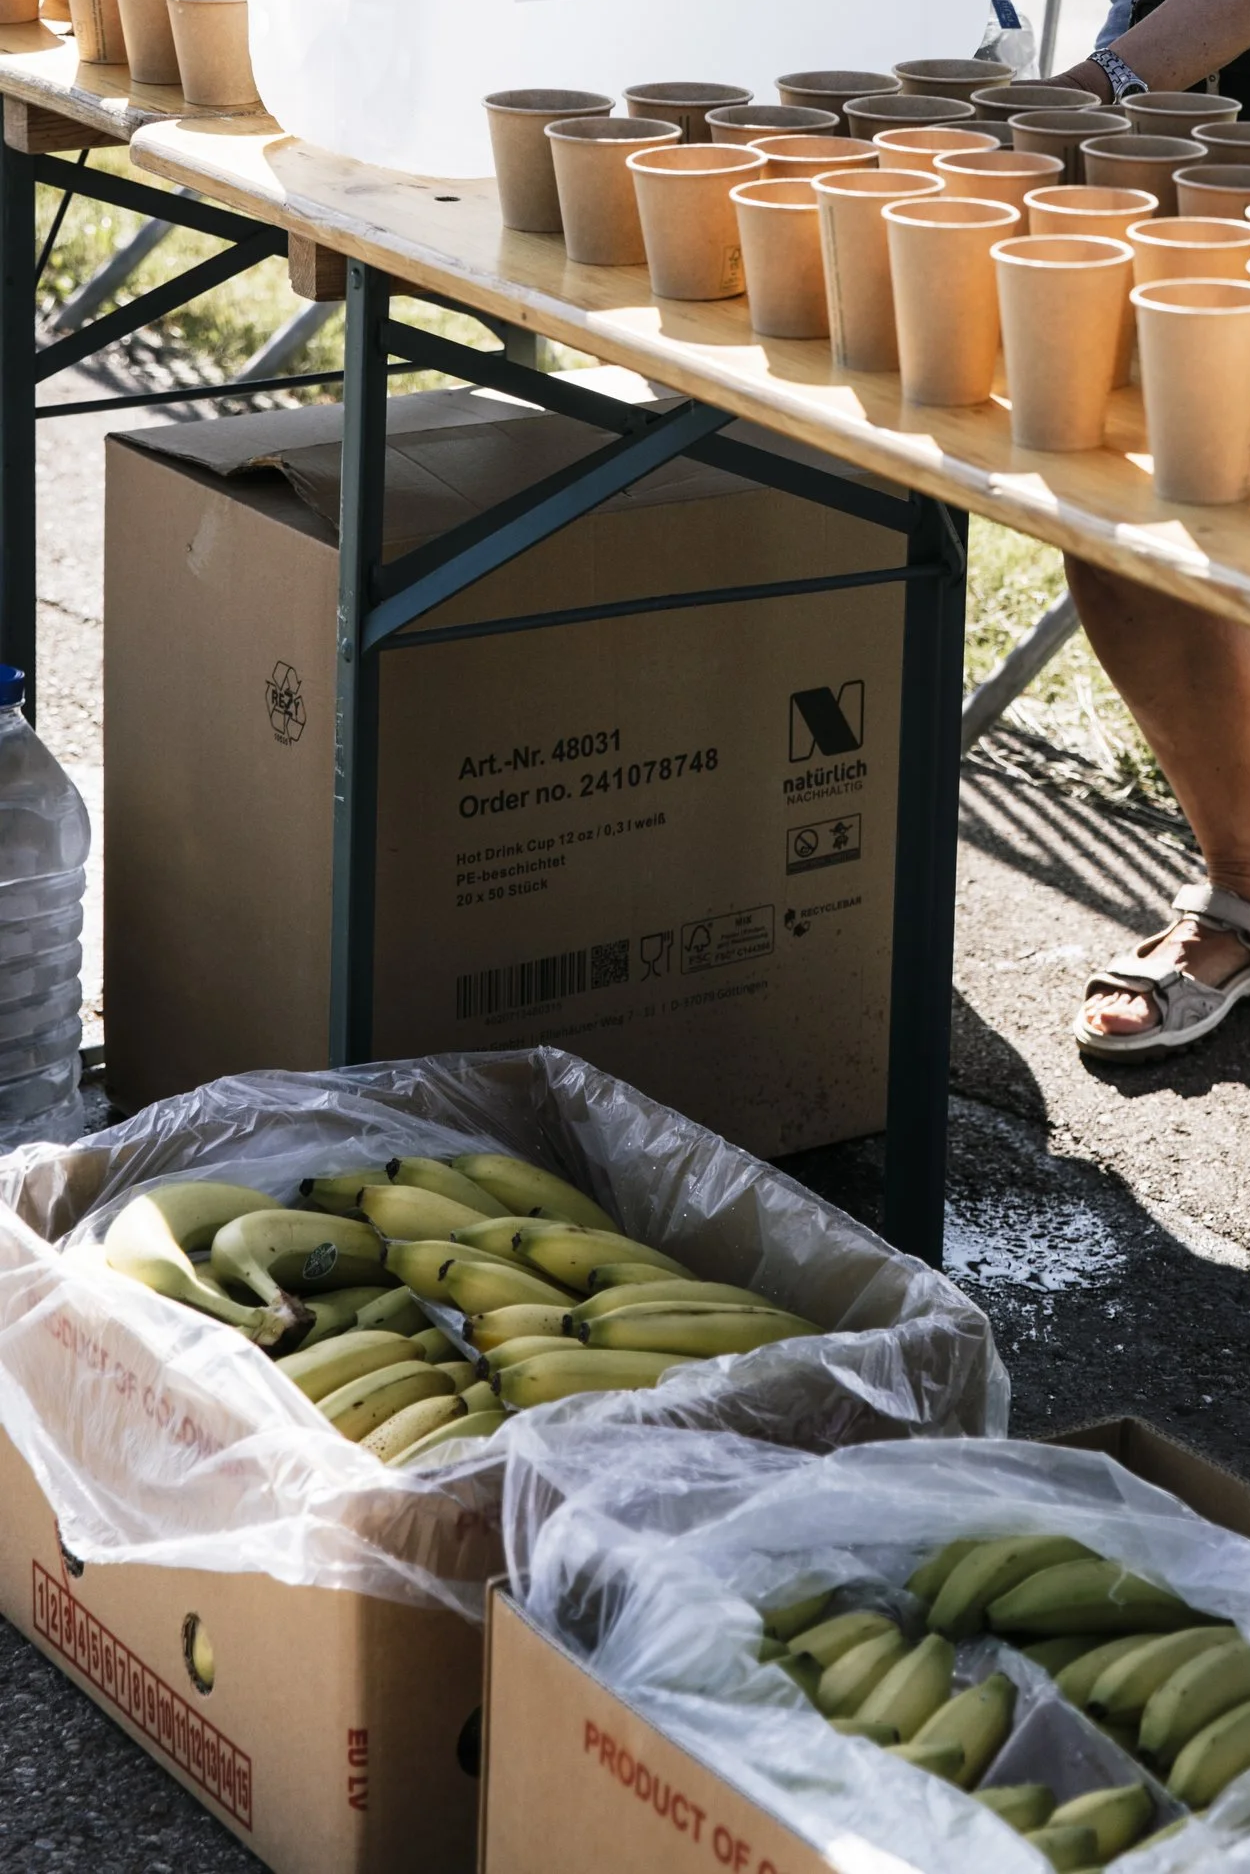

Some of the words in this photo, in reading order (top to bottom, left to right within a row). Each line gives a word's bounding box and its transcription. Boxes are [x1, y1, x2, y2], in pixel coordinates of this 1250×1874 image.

[458, 746, 545, 780] Art.-Nr.
[551, 728, 621, 763] 48031
[458, 789, 531, 819] Order
[535, 784, 572, 805] no.
[579, 747, 719, 798] 241078748
[783, 759, 868, 794] natürlich
[786, 780, 864, 806] NACHHALTIG
[456, 851, 482, 867] Hot
[484, 841, 524, 861] Drink
[527, 837, 555, 853] Cup
[559, 832, 575, 847] 12
[577, 829, 594, 842] oz
[604, 821, 624, 838] 0,3
[634, 812, 667, 830] weiß
[456, 853, 566, 887] PE-beschichtet
[456, 892, 473, 907] 20
[477, 892, 485, 904] x
[488, 887, 505, 901] 50
[508, 877, 548, 897] Stück
[800, 894, 863, 918] RECYCLEBAR
[38, 1582, 44, 1619] 1
[50, 1593, 58, 1632] 2
[64, 1604, 73, 1644] 3
[79, 1619, 86, 1657] 4
[91, 1630, 99, 1670] 5
[105, 1644, 113, 1684] 6
[118, 1657, 126, 1696] 7
[132, 1670, 140, 1711] 8
[147, 1684, 155, 1724] 9
[160, 1696, 172, 1739] 10
[175, 1710, 187, 1753] 11
[190, 1724, 202, 1766] 12
[205, 1737, 218, 1782] 13
[220, 1752, 233, 1796] 14
[235, 1765, 248, 1811] 15
[348, 1728, 369, 1767] EU
[348, 1776, 369, 1811] LV
[584, 1719, 707, 1843] PRODUCT
[712, 1825, 751, 1873] OF
